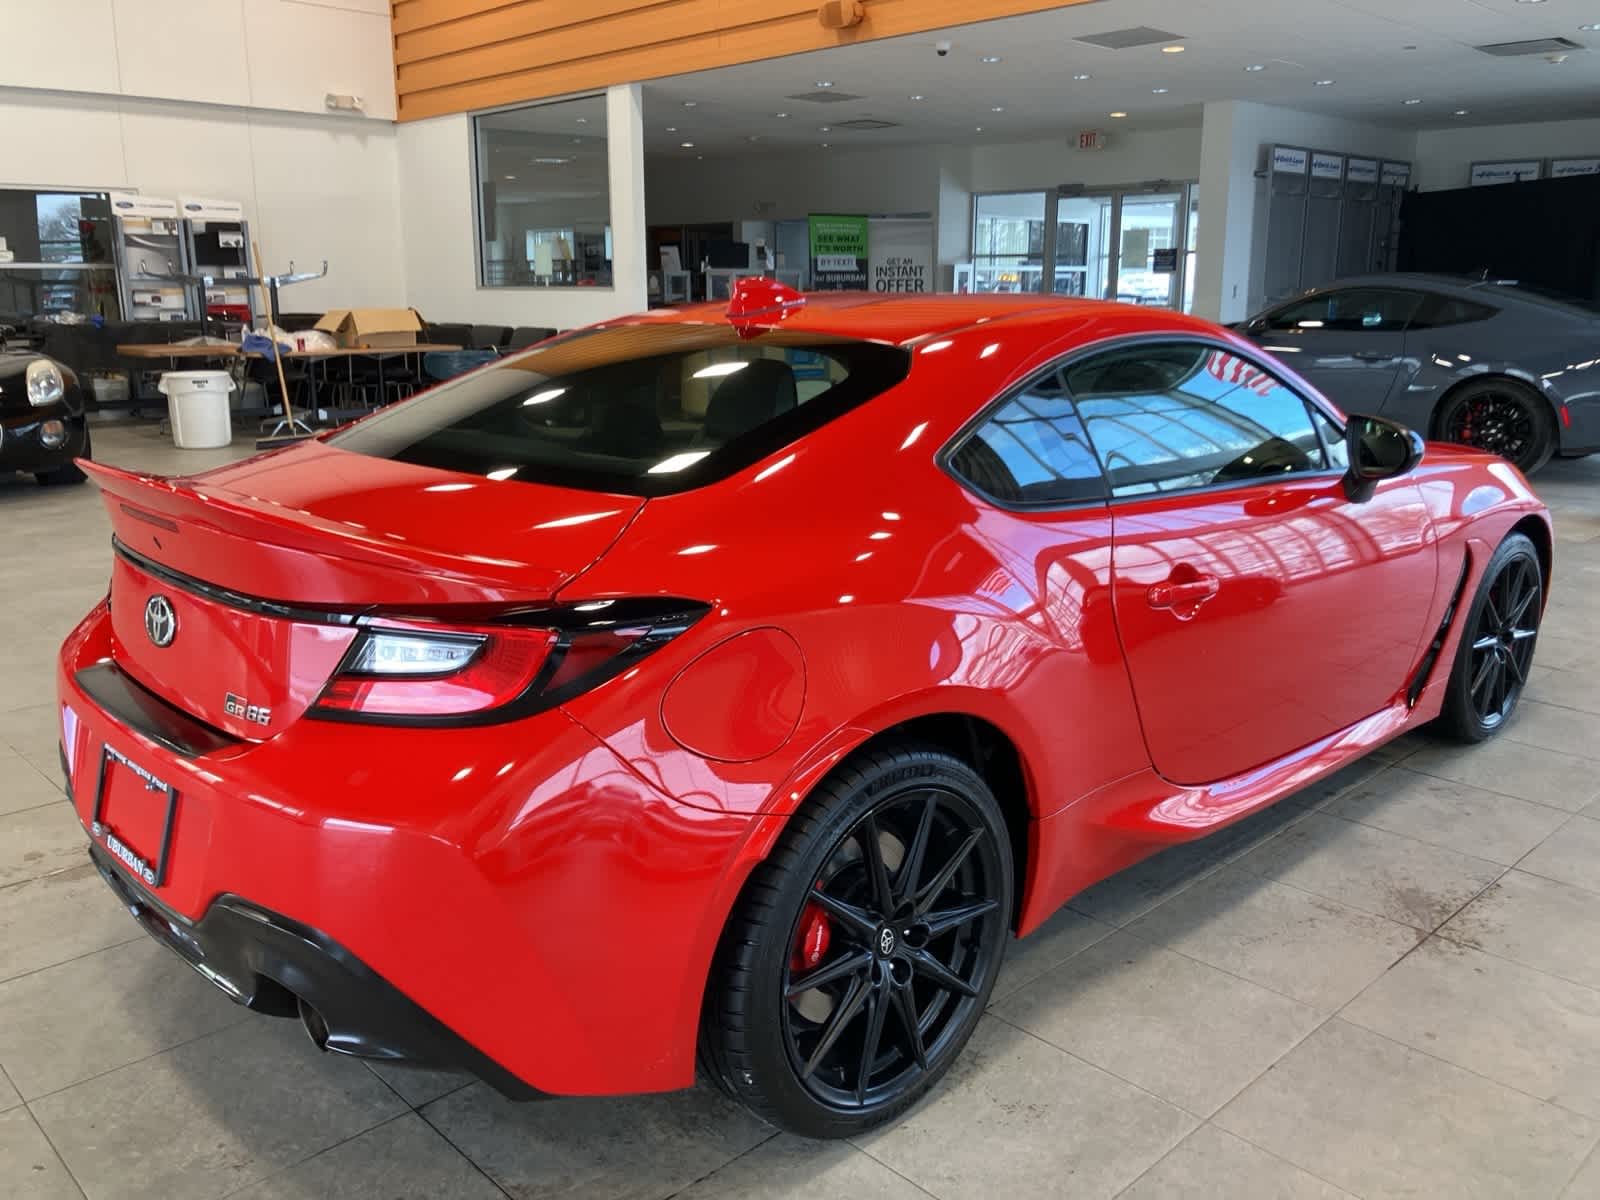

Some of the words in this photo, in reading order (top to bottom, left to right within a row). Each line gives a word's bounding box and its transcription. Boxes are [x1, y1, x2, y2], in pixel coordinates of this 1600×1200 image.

[817, 234, 833, 243] SEE
[836, 234, 861, 243] WHAT
[833, 244, 864, 253] WORTH
[887, 257, 900, 265] GET
[903, 257, 913, 265] AN
[876, 266, 924, 277] INSTANT
[876, 279, 924, 292] OFFER
[107, 834, 145, 876] UBURBAN
